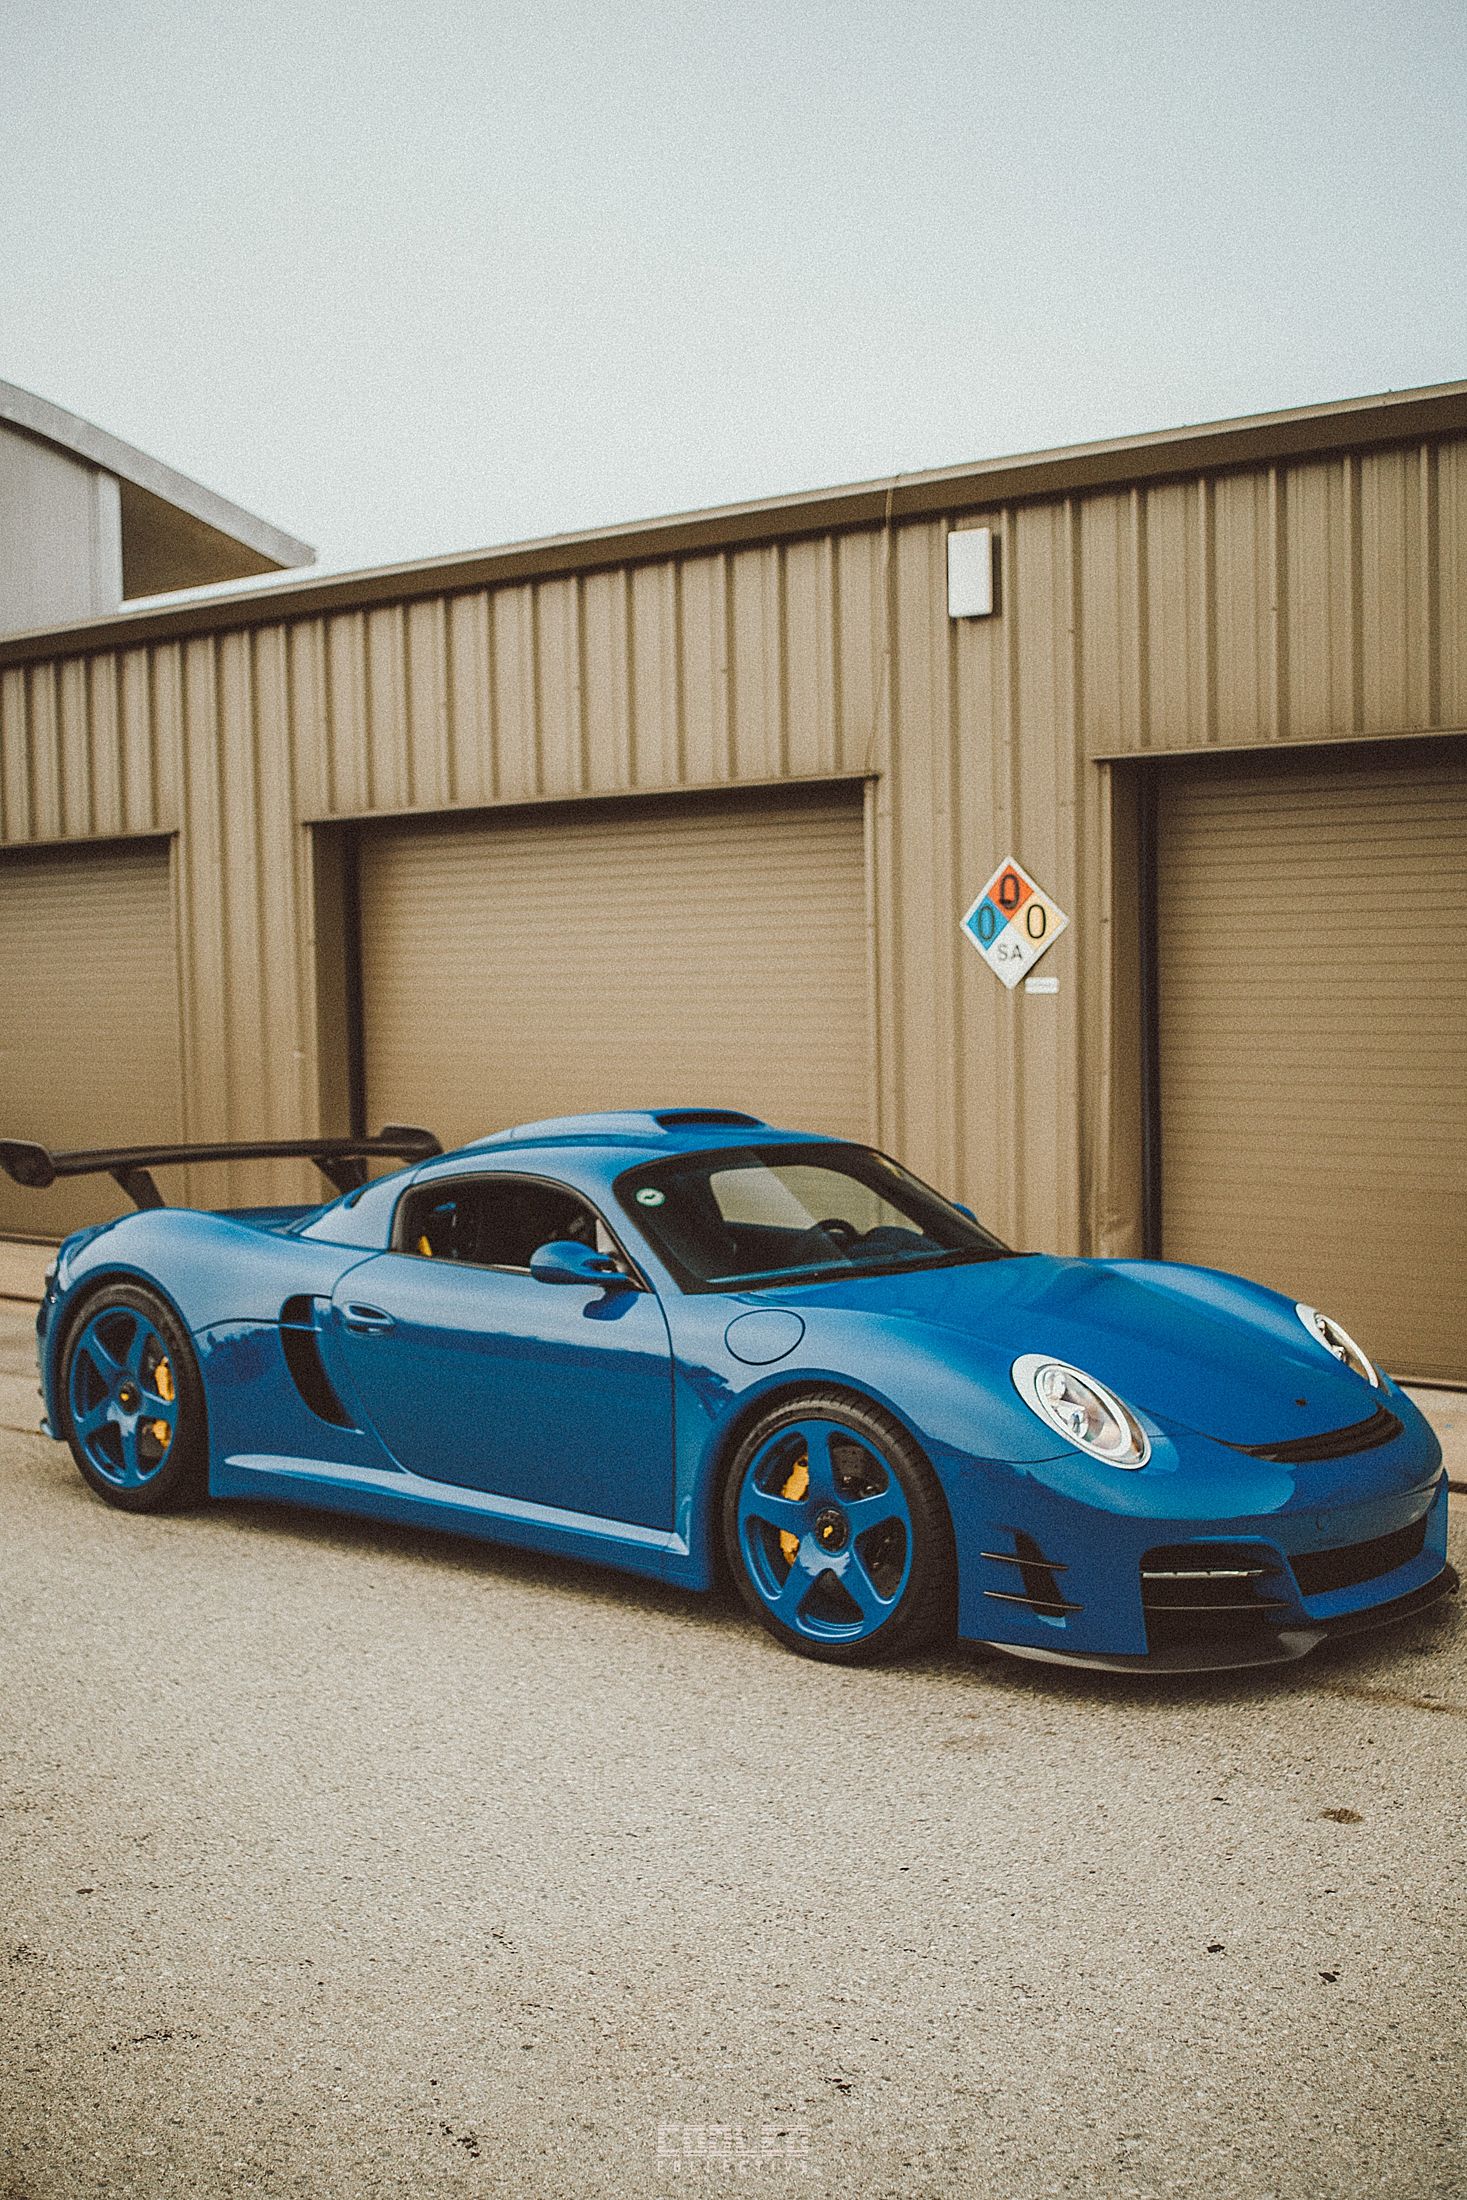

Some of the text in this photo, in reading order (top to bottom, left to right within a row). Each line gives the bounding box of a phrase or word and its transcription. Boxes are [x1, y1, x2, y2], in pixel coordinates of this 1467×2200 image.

[999, 873, 1020, 910] 0
[977, 905, 995, 940] 0
[1026, 904, 1047, 939] 0
